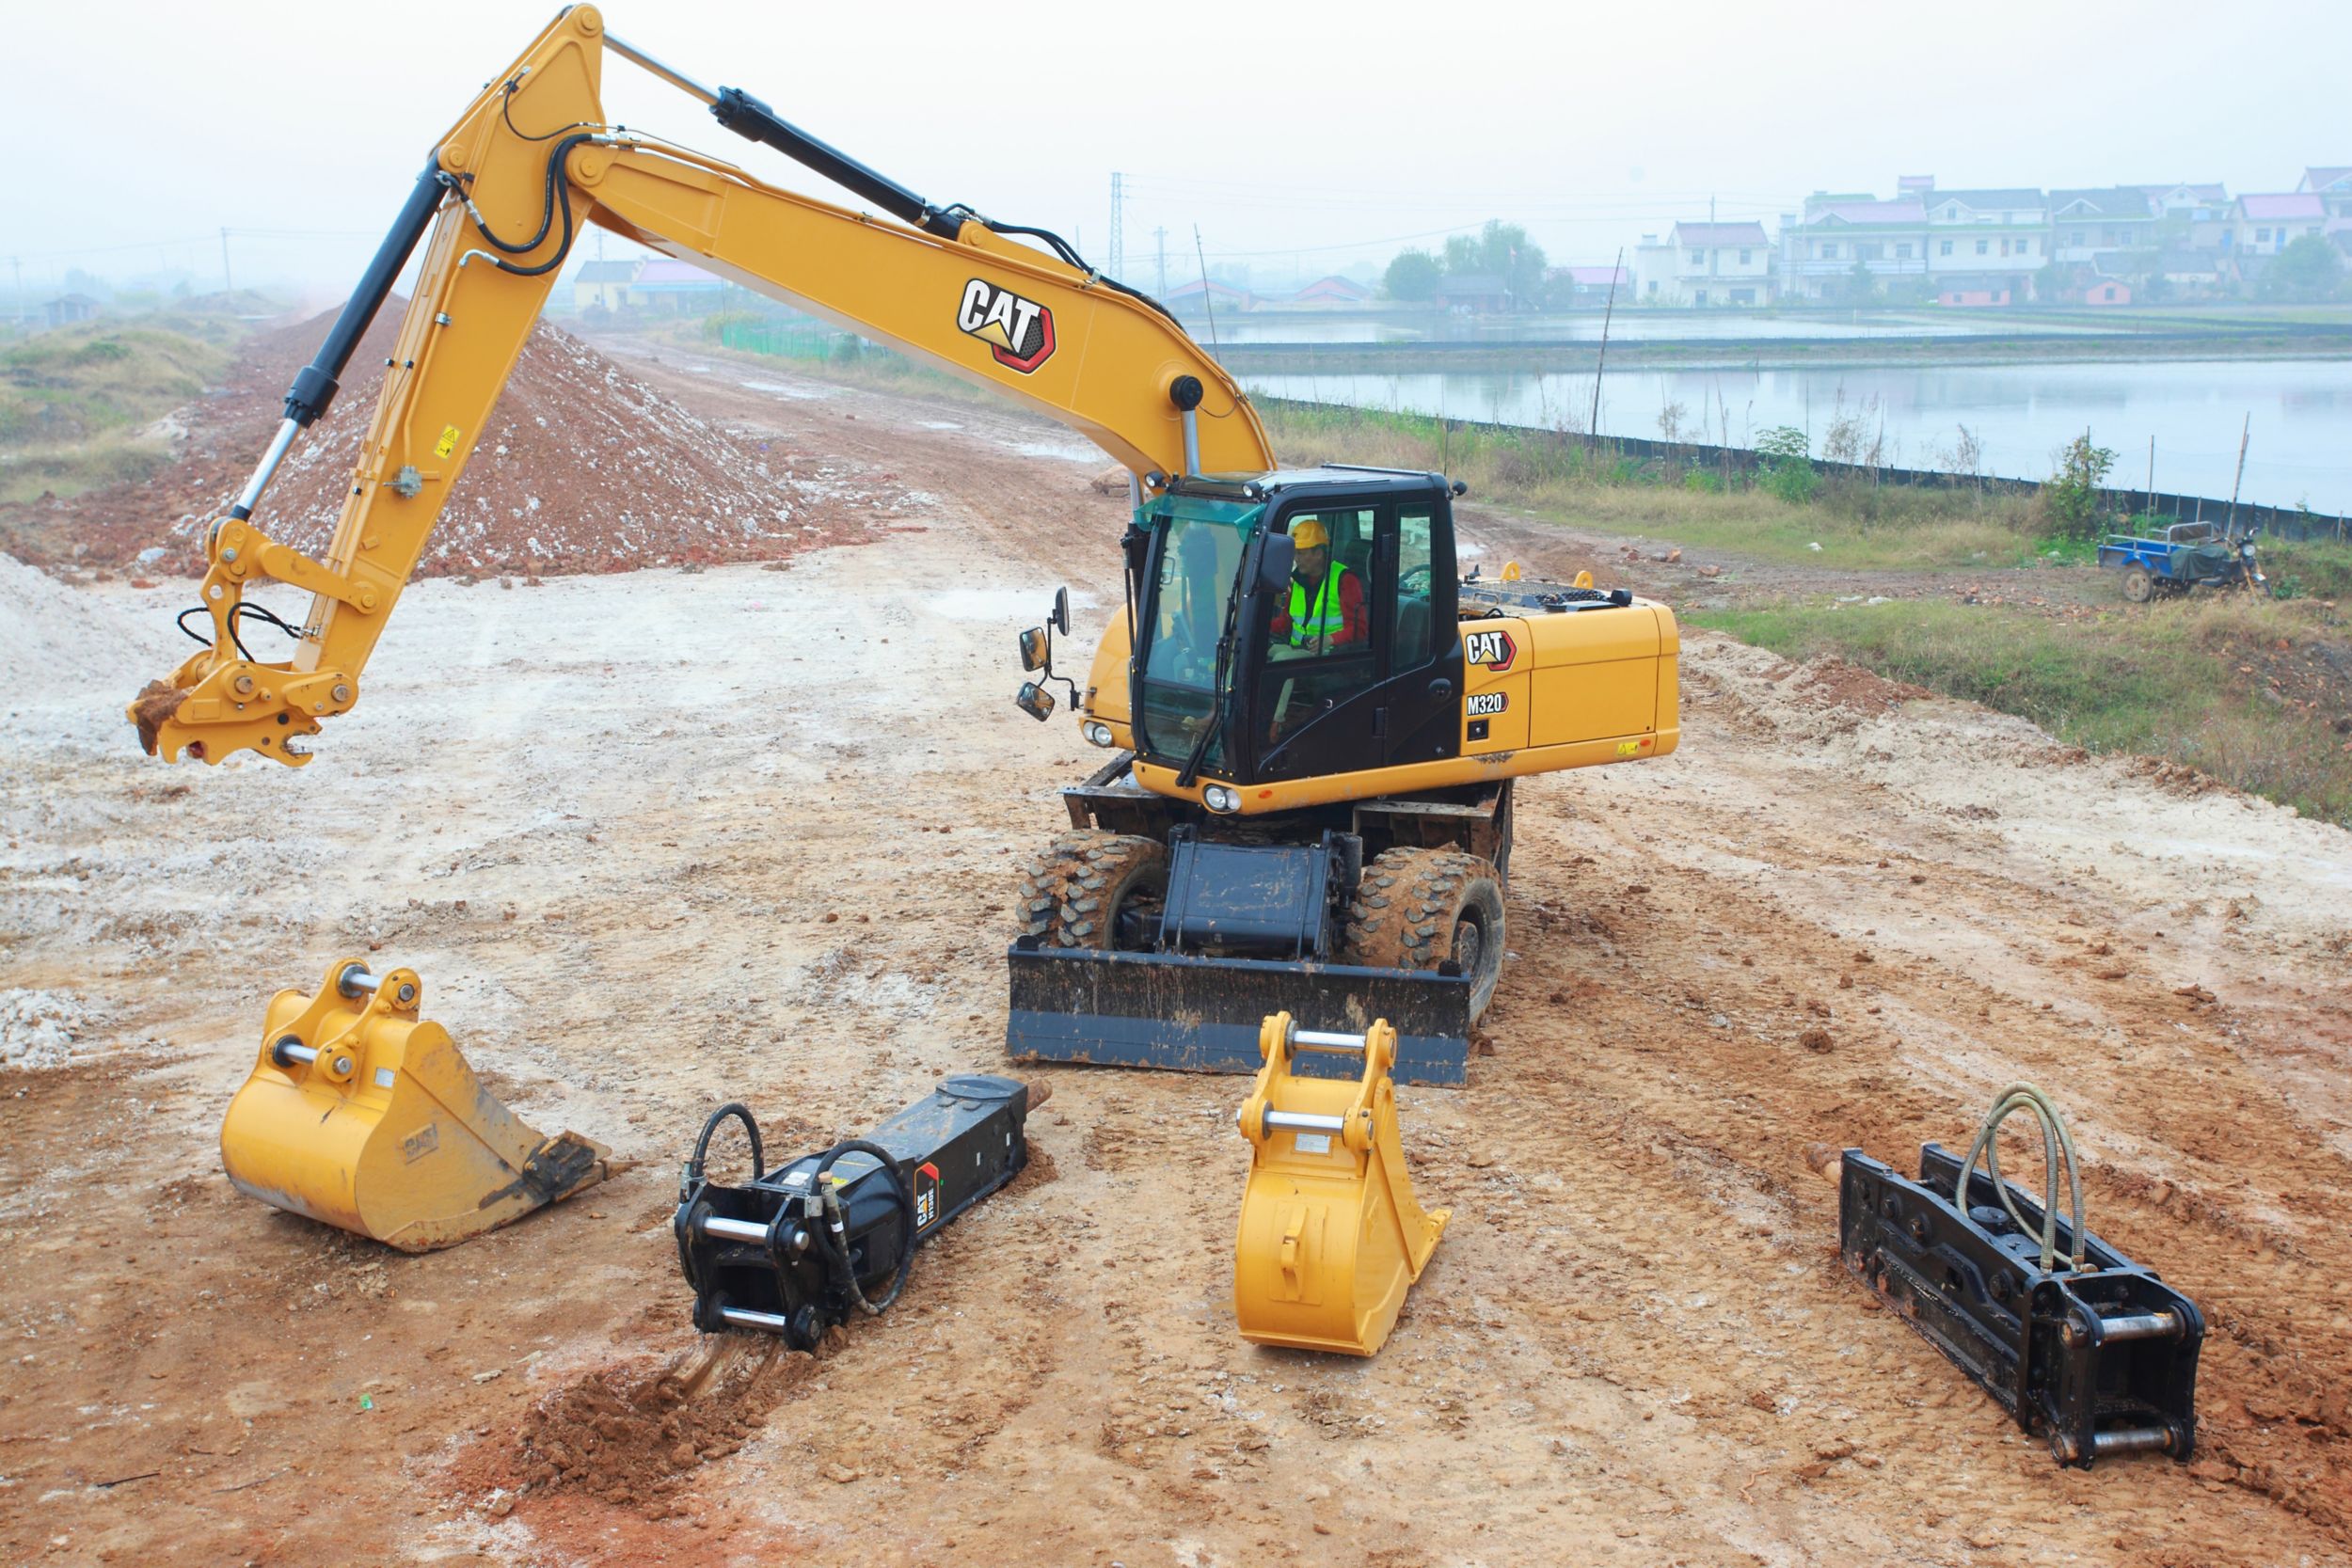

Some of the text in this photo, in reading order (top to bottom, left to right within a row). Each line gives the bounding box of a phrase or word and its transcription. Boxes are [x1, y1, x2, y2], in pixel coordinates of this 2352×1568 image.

[958, 279, 1041, 354] CAT
[1466, 631, 1502, 664] CAT
[1468, 693, 1502, 715] M320
[916, 1192, 928, 1227] CAT
